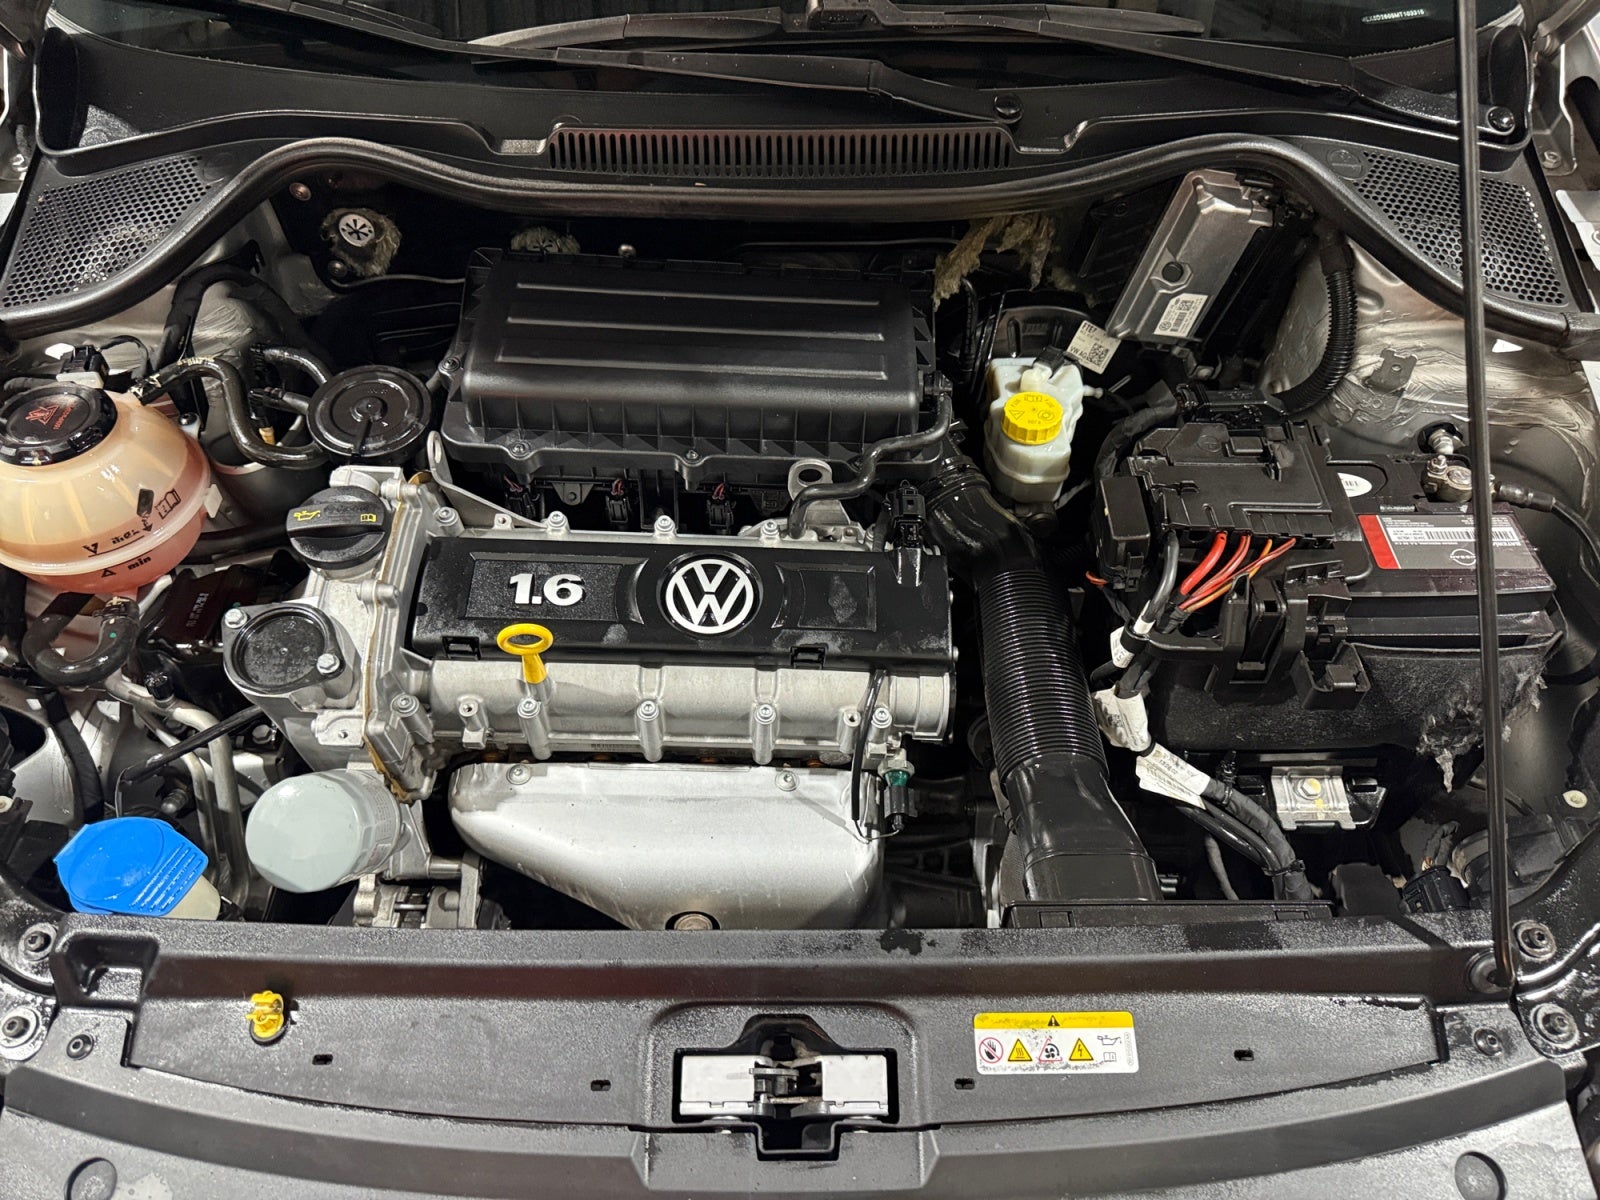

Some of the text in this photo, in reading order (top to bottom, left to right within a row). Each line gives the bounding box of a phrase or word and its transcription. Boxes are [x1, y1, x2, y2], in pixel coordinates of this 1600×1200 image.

[127, 556, 152, 570] min
[509, 573, 583, 606] 1.6
[666, 558, 755, 635] VW
